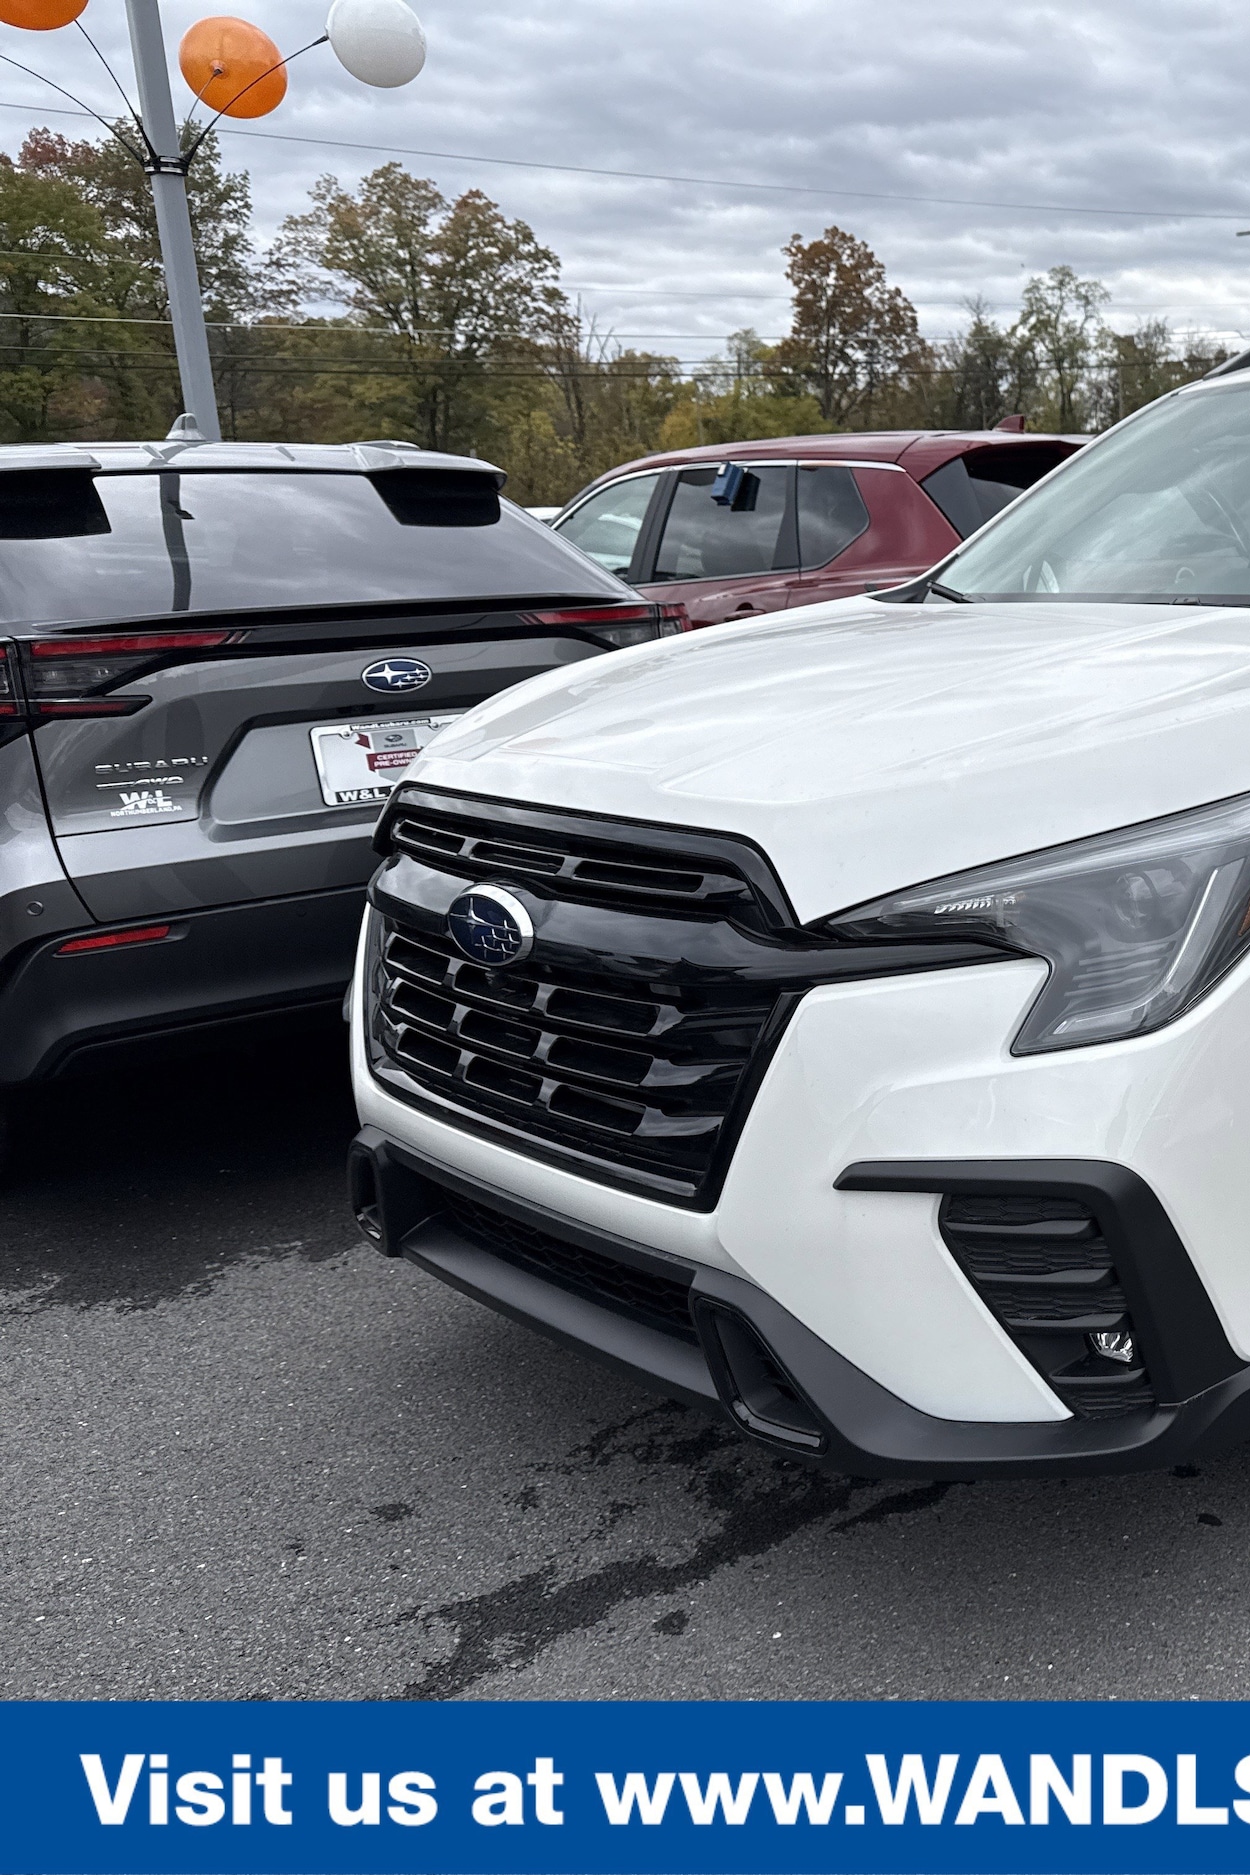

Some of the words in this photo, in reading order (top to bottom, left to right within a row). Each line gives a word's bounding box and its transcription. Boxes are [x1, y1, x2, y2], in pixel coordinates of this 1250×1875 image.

[374, 758, 411, 768] PRE-OWN
[377, 751, 417, 761] CERTIFIED
[95, 756, 208, 774] SUBARU
[119, 790, 173, 811] W&L
[340, 787, 385, 802] W&L
